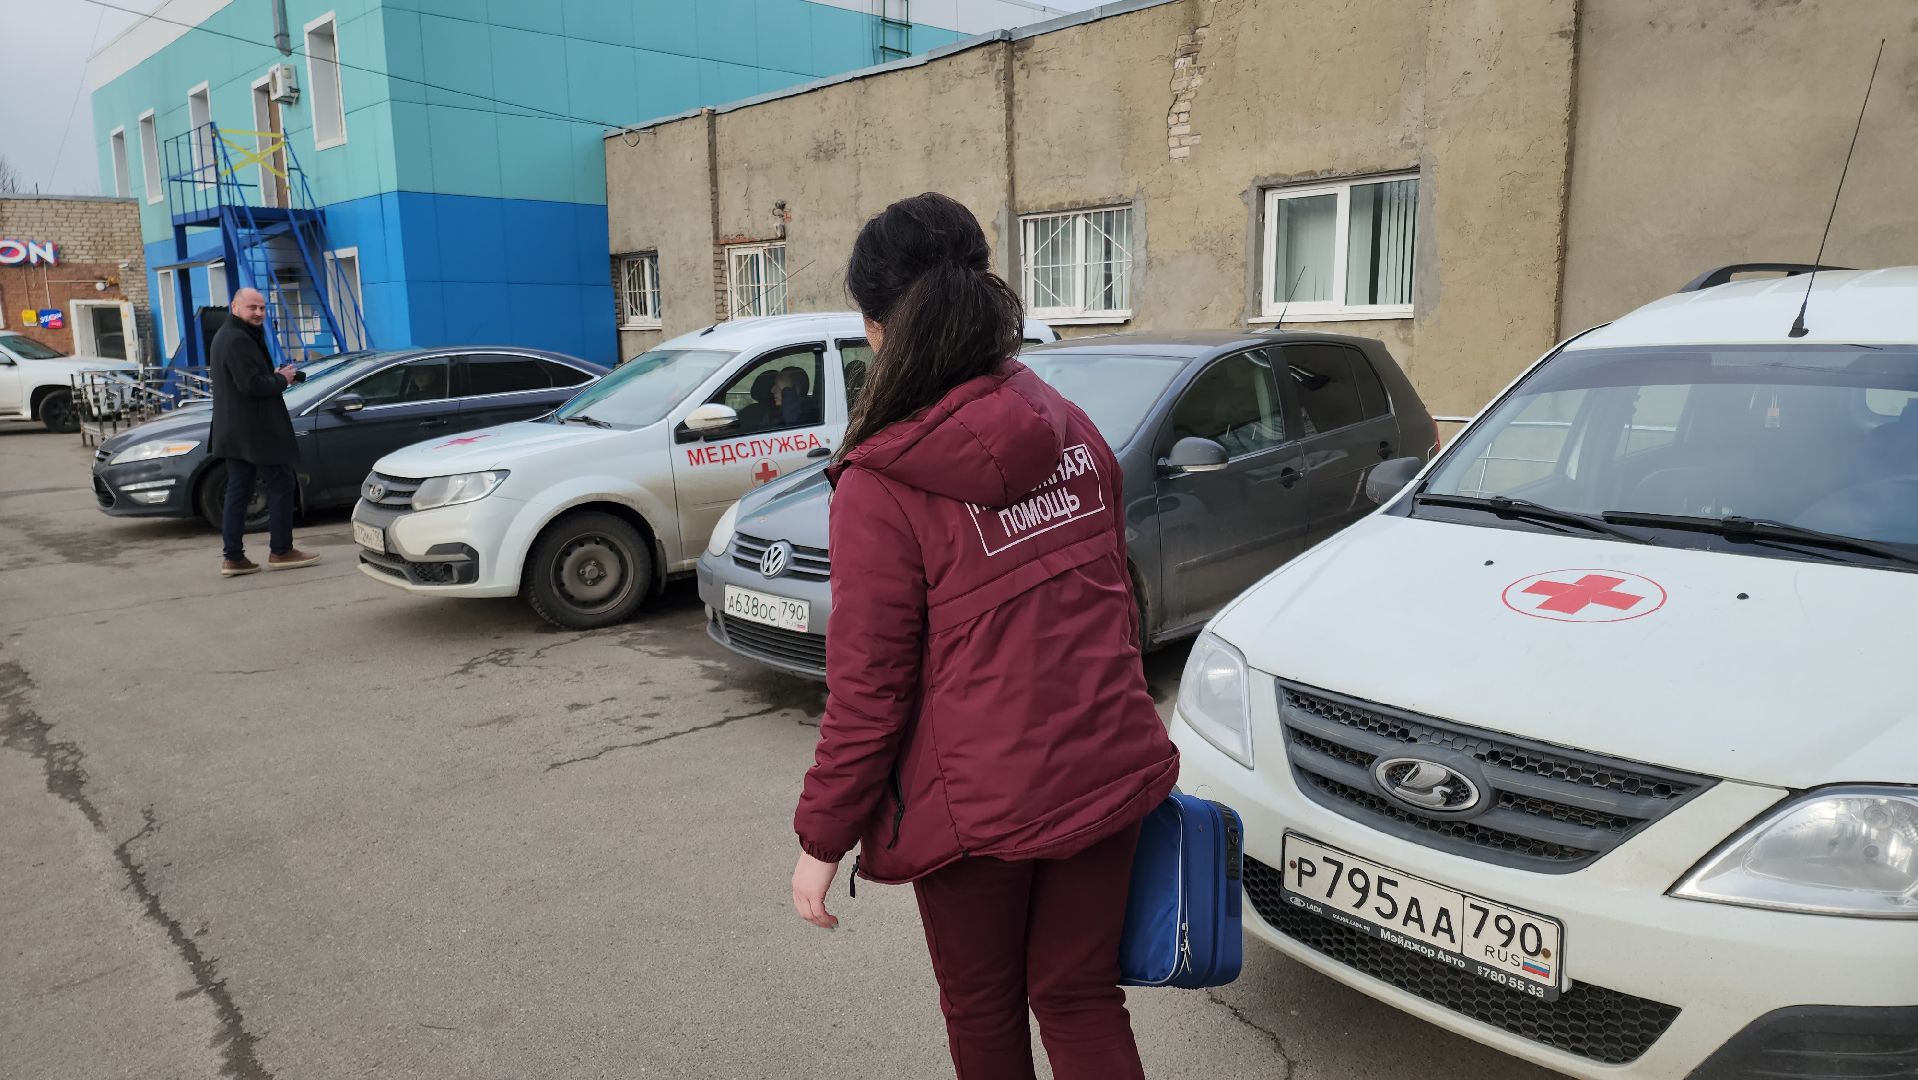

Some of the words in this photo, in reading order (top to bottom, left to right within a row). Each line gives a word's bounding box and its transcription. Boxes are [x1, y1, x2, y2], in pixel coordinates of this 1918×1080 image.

[687, 433, 822, 467] МЕДСЛУЖБА
[997, 486, 1081, 538] ПОМОЩЬ
[1296, 855, 1456, 944] Р795АА
[1469, 903, 1543, 957] 790
[1306, 902, 1323, 915] LADA
[1380, 928, 1435, 960] Мэйджор
[1437, 951, 1466, 969] Авто
[1484, 944, 1521, 967] RUS
[1482, 967, 1507, 985] 780
[1508, 976, 1525, 991] 55
[1527, 984, 1544, 998] 33
